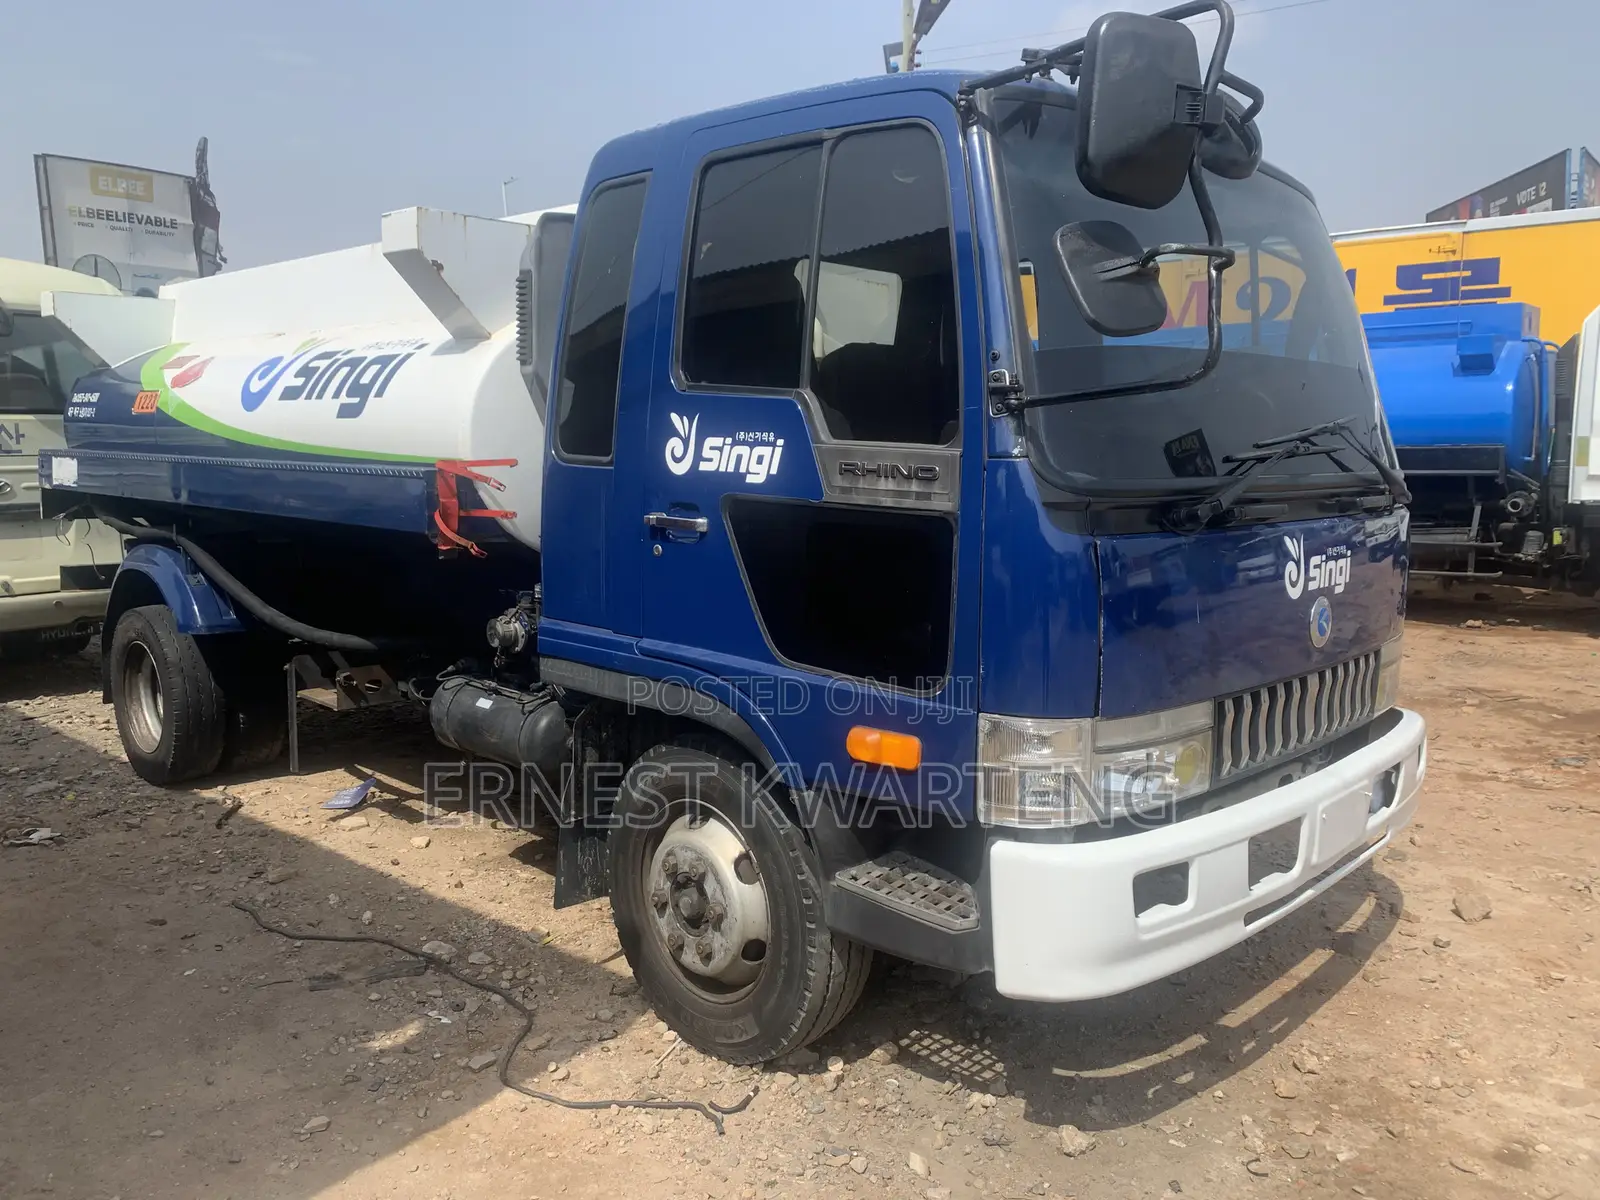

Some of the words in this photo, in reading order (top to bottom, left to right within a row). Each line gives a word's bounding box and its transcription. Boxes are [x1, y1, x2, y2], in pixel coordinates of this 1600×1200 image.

[1516, 185, 1537, 206] VOTE
[68, 205, 179, 230] ELBEELIEVABLE
[278, 343, 429, 419] Singi
[698, 436, 785, 484] Singi
[838, 460, 940, 481] RHINO
[1308, 550, 1352, 595] Singi
